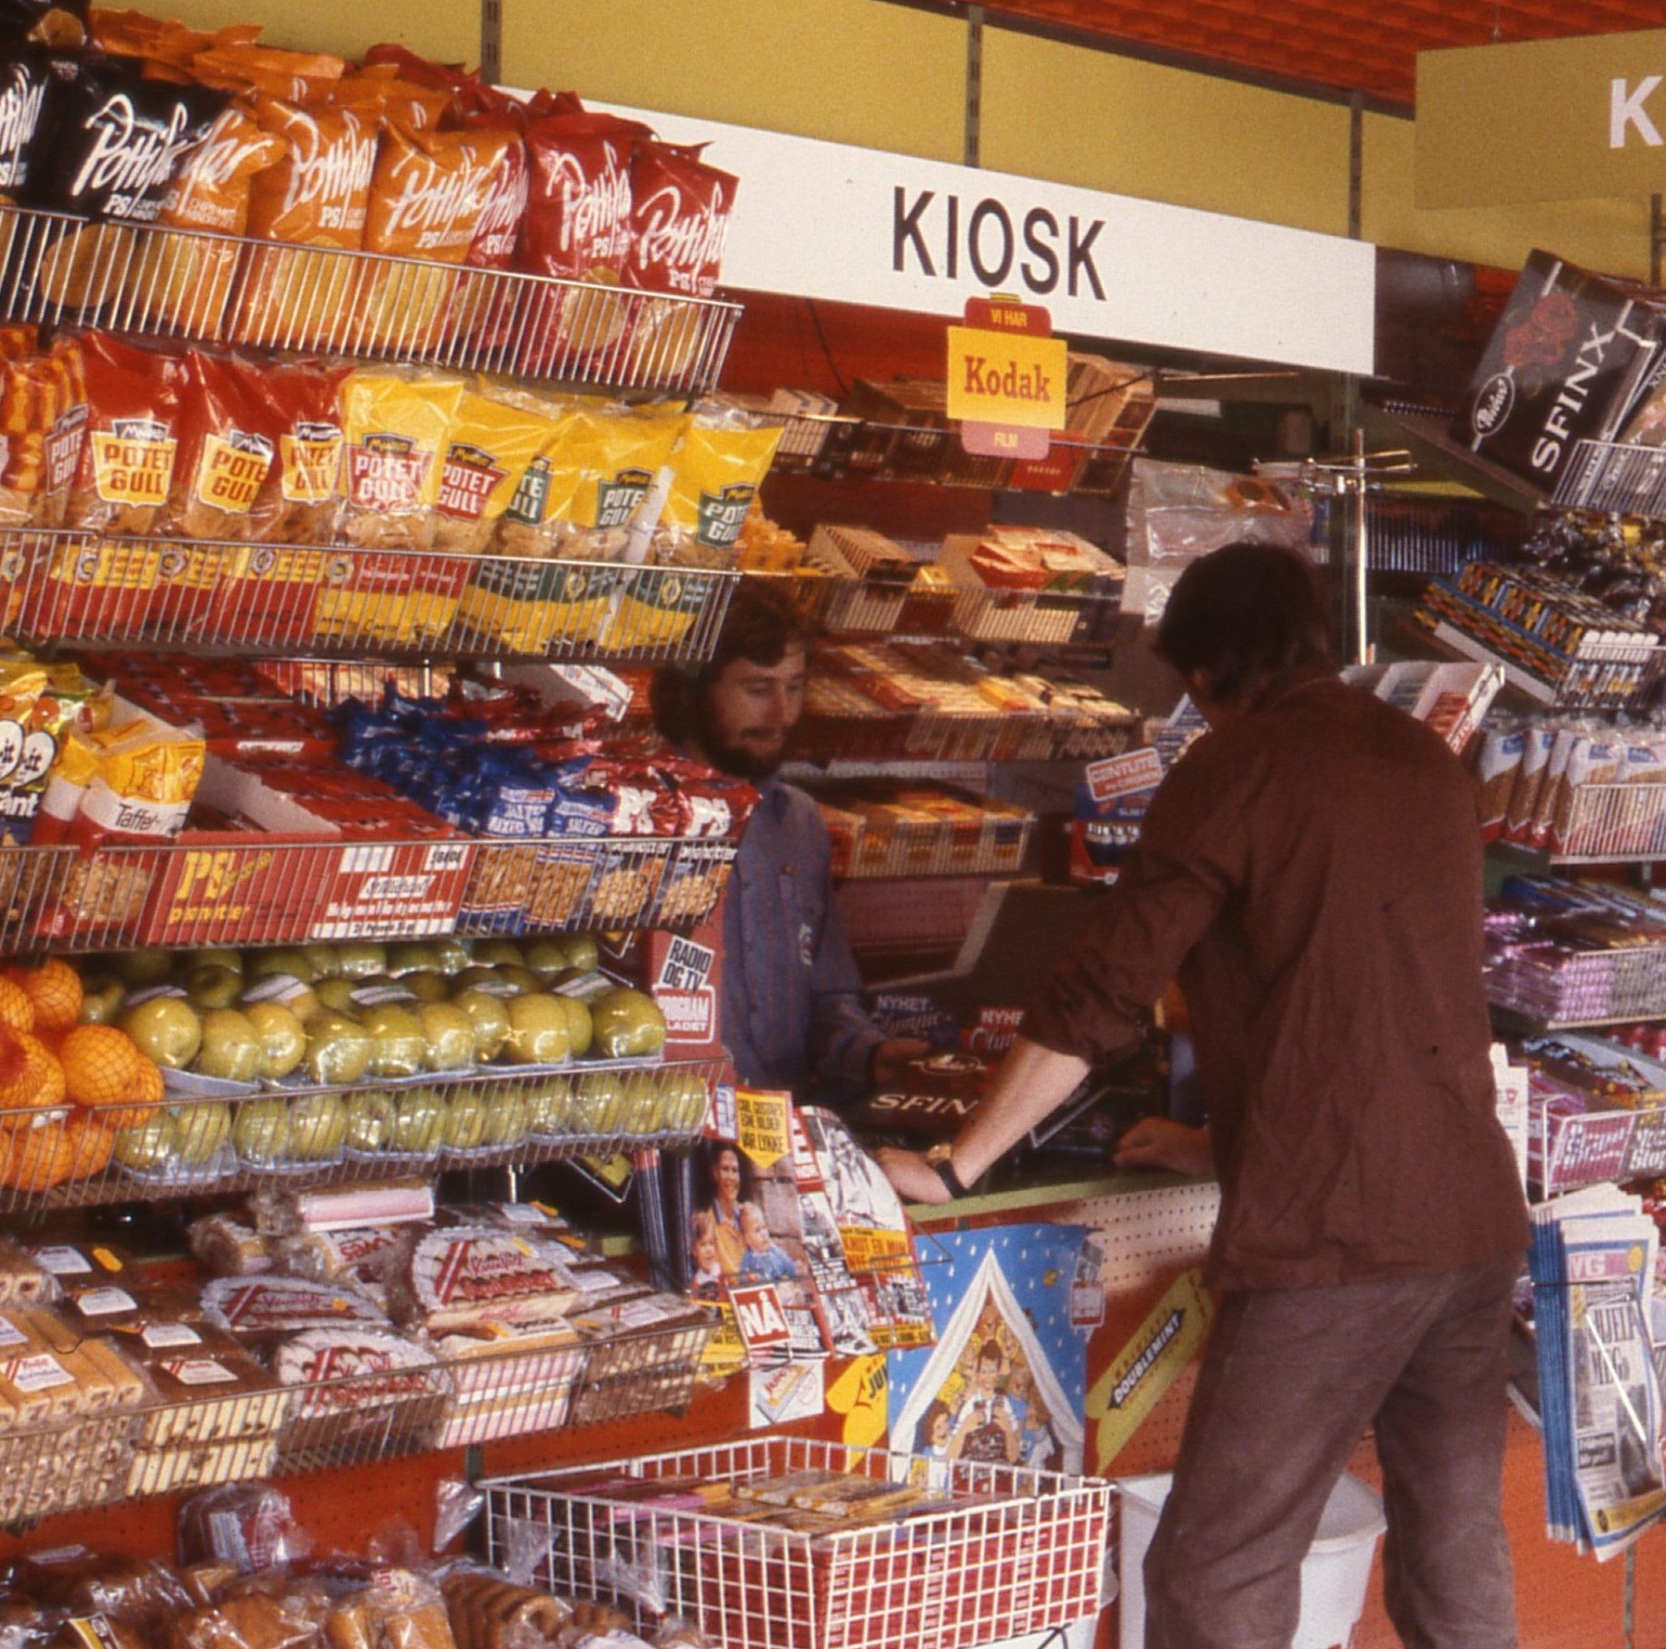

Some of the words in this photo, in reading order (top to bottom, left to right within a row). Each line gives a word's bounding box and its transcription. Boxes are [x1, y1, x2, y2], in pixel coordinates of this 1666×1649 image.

[892, 185, 1107, 302] KIOSK
[990, 308, 1006, 326] VI
[1007, 309, 1028, 328] HAR
[963, 353, 1051, 405] Kodak
[1532, 323, 1617, 474] SFINX
[50, 431, 85, 465] POTE
[993, 431, 1019, 450] FILM
[104, 443, 173, 473] POTET
[211, 450, 267, 482] POTE
[354, 453, 424, 483] POTET
[108, 469, 166, 497] GULL
[668, 939, 711, 972] RADIO
[662, 960, 682, 986] OG
[683, 970, 703, 993] TV
[870, 1093, 980, 1116] SFIN
[738, 1293, 788, 1343] NÅ
[1112, 1308, 1184, 1403] DOUBLEMINT
